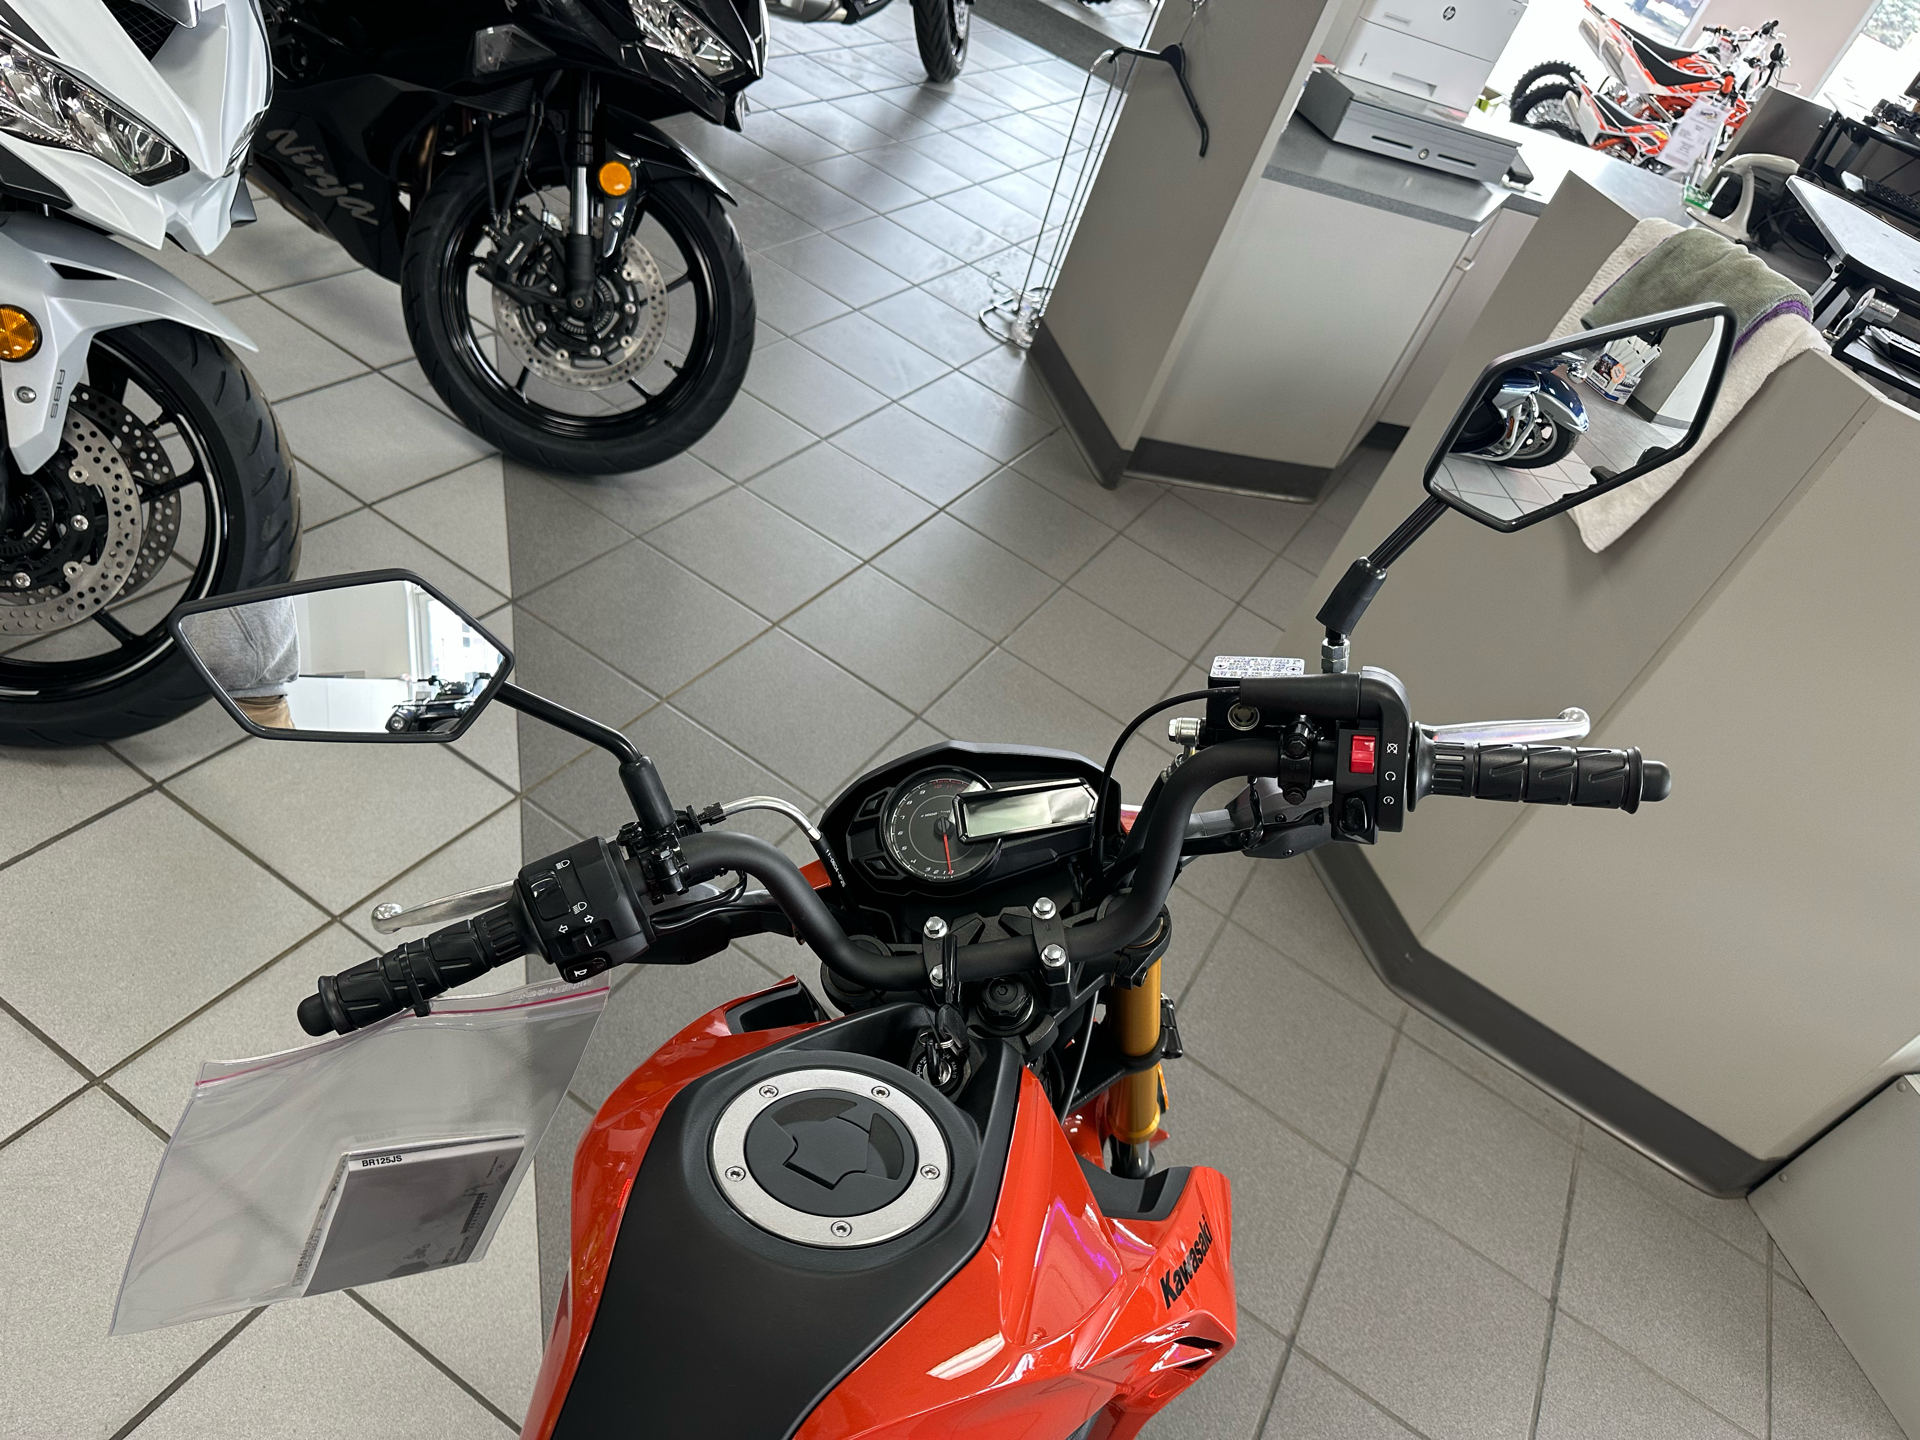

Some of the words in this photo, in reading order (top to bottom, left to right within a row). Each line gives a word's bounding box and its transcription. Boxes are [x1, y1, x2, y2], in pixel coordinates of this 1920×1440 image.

[266, 129, 379, 226] Ninja
[50, 369, 66, 419] ABS
[361, 1154, 403, 1168] BR125JS
[1159, 1213, 1213, 1310] Kawasaki
